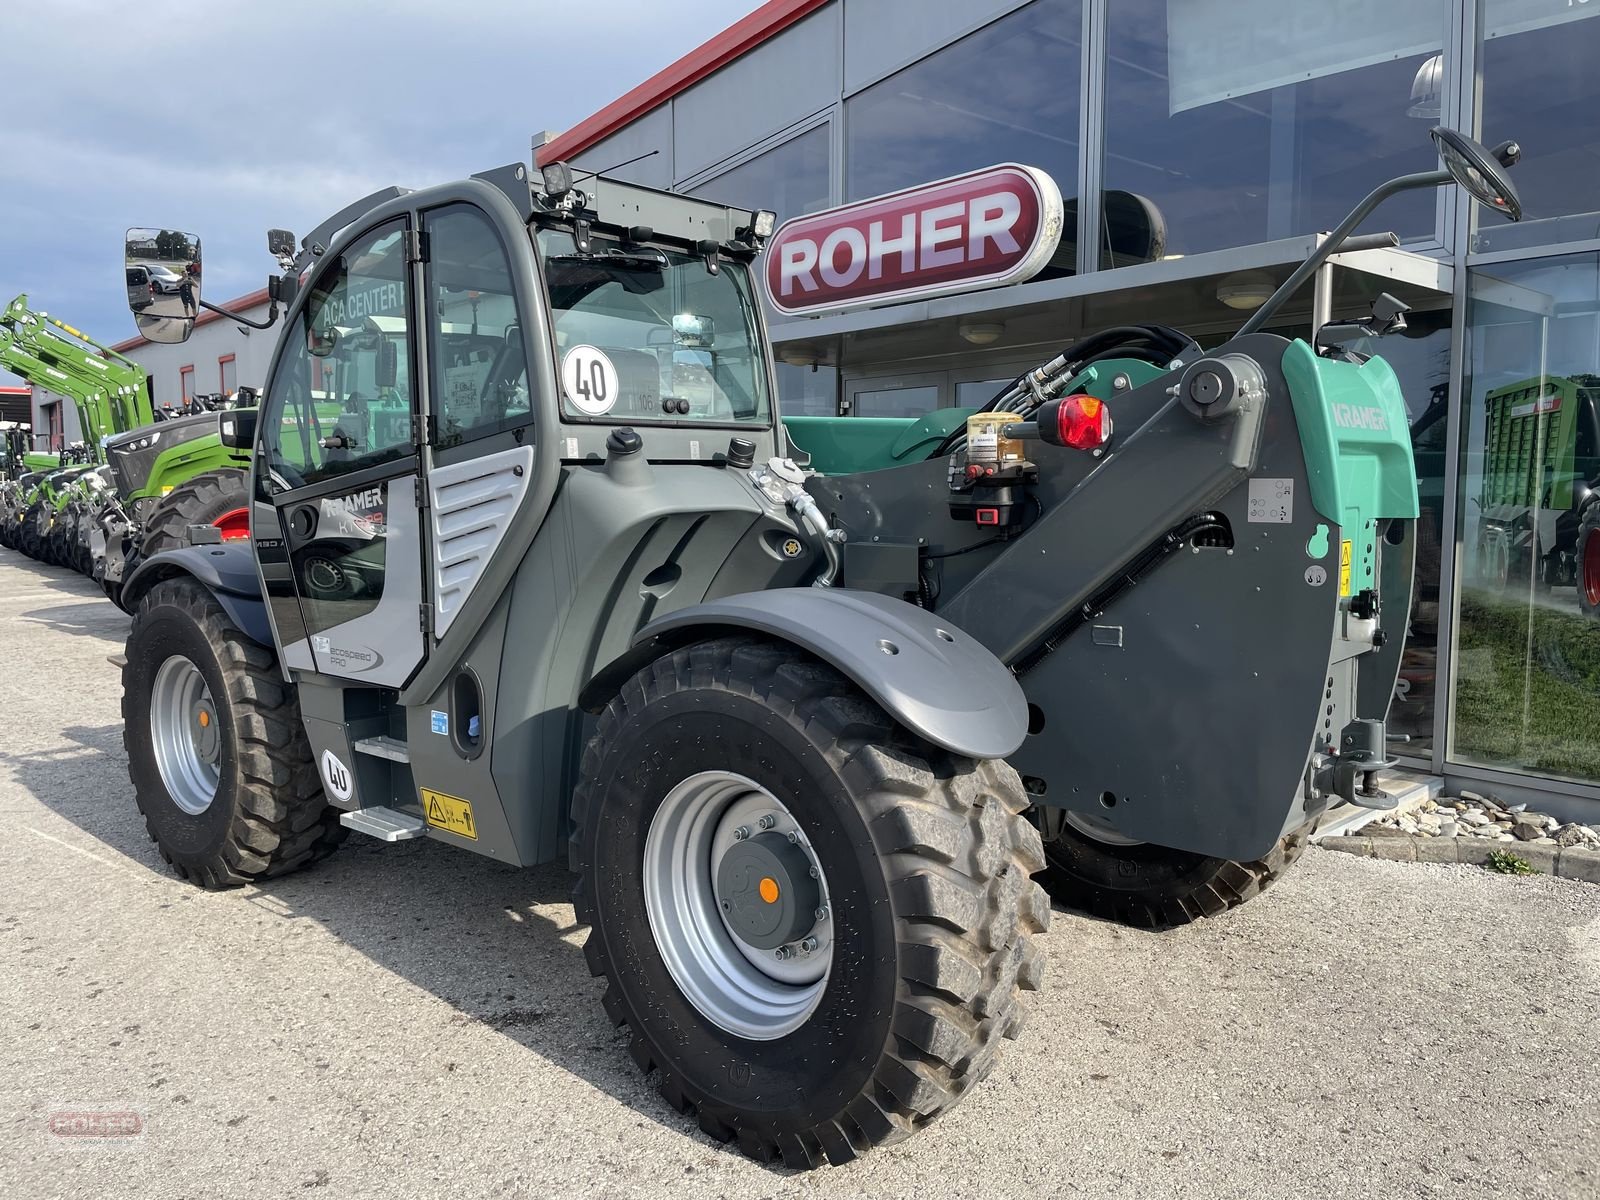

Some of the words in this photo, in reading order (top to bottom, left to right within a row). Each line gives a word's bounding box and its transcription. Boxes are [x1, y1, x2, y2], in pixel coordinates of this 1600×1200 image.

[780, 191, 1022, 297] ROHER
[323, 299, 346, 327] ACA
[348, 283, 397, 319] CENTER
[575, 358, 607, 401] 40
[1331, 402, 1389, 431] KRAMER
[324, 486, 384, 518] KRAMER
[330, 648, 371, 662] ecospeed
[330, 656, 347, 667] PRO
